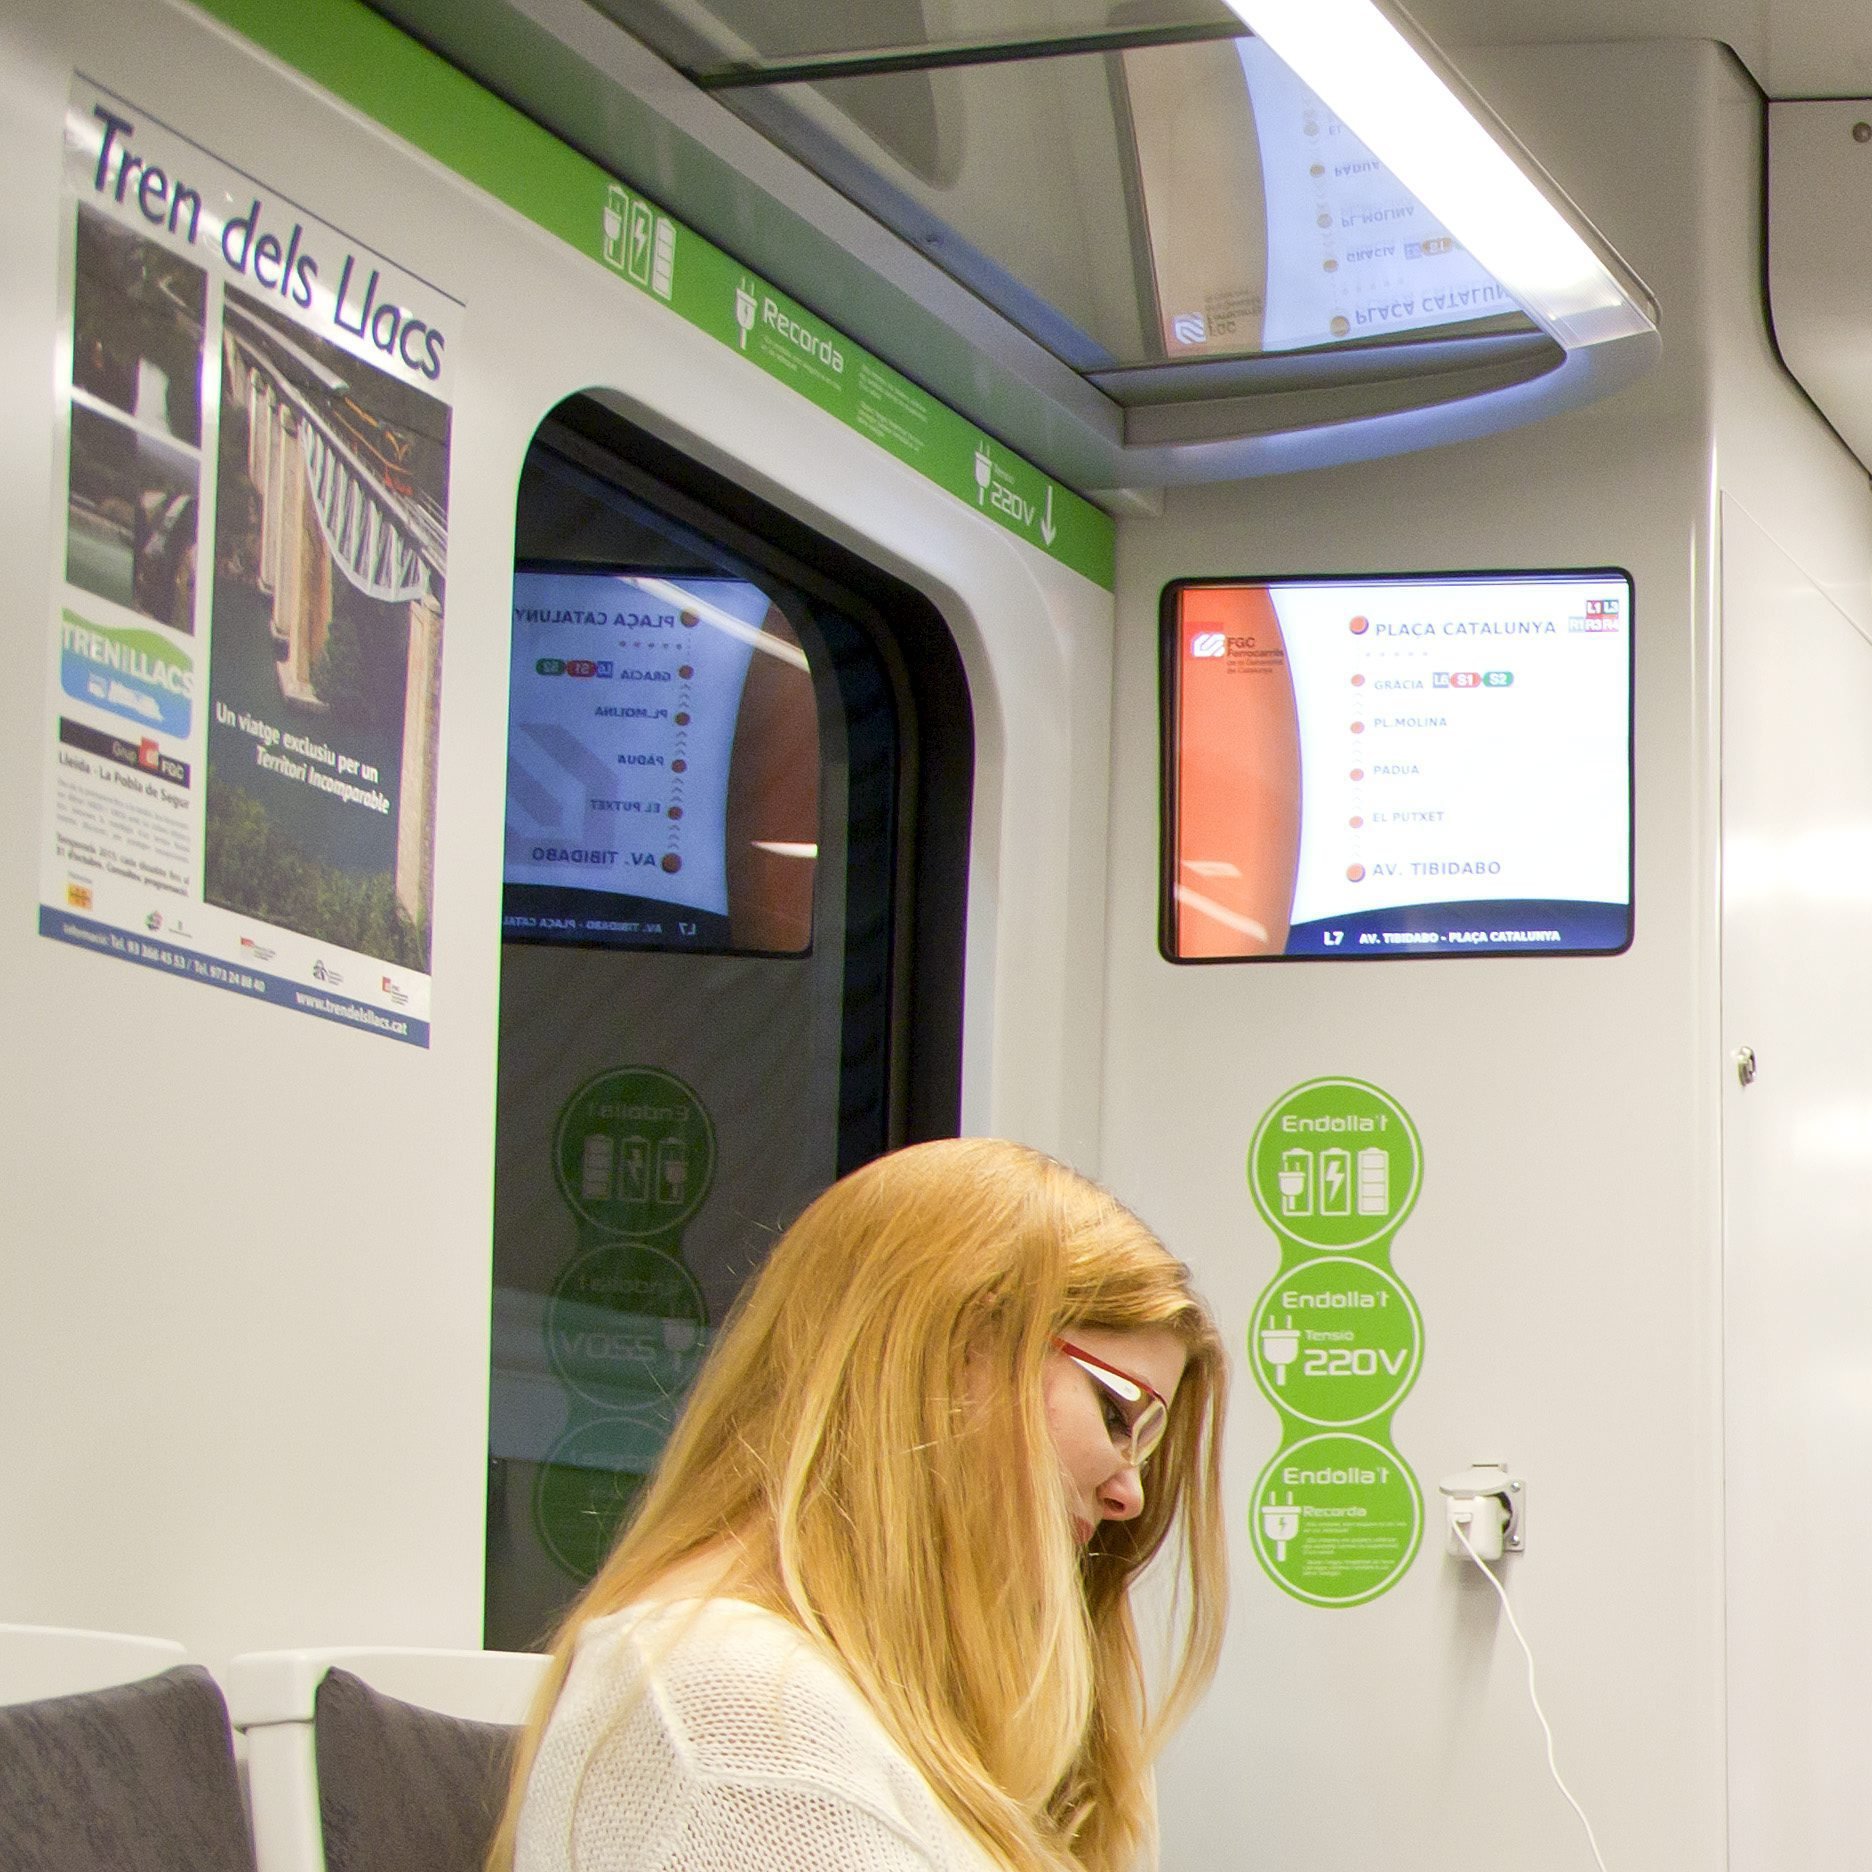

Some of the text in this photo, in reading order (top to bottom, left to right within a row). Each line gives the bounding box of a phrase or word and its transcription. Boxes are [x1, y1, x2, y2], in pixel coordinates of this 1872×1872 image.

[92, 105, 446, 382] Tren dels Llacs
[764, 297, 844, 374] Recorda
[990, 480, 1035, 527] 220V
[1375, 621, 1557, 640] PLAÇA CATALUNYA
[1227, 637, 1256, 648] FGC
[62, 623, 193, 699] TRENILLACS
[1456, 673, 1475, 687] S1
[1488, 673, 1508, 686] S2
[1373, 717, 1448, 729] PL.MOLINA
[215, 701, 380, 784] Un viatge exclusiu per un
[256, 745, 390, 814] Territori Incomparable
[1373, 765, 1420, 775] PADUA
[1372, 811, 1445, 823] EL PUTXET
[1372, 861, 1502, 877] AV. TIBIDABO
[1323, 931, 1344, 945] L7
[1359, 933, 1381, 944] AV.
[1382, 932, 1439, 944] TIBIDABO
[1448, 931, 1489, 945] PLAÇA
[1489, 930, 1561, 943] CATALUNYA
[1281, 1113, 1389, 1134] Endolla't
[1281, 1290, 1390, 1310] Endolla't
[1303, 1328, 1354, 1342] Tensió
[1303, 1348, 1408, 1377] 220V
[1282, 1466, 1390, 1486] Endolla't
[1303, 1506, 1367, 1517] Recorda
